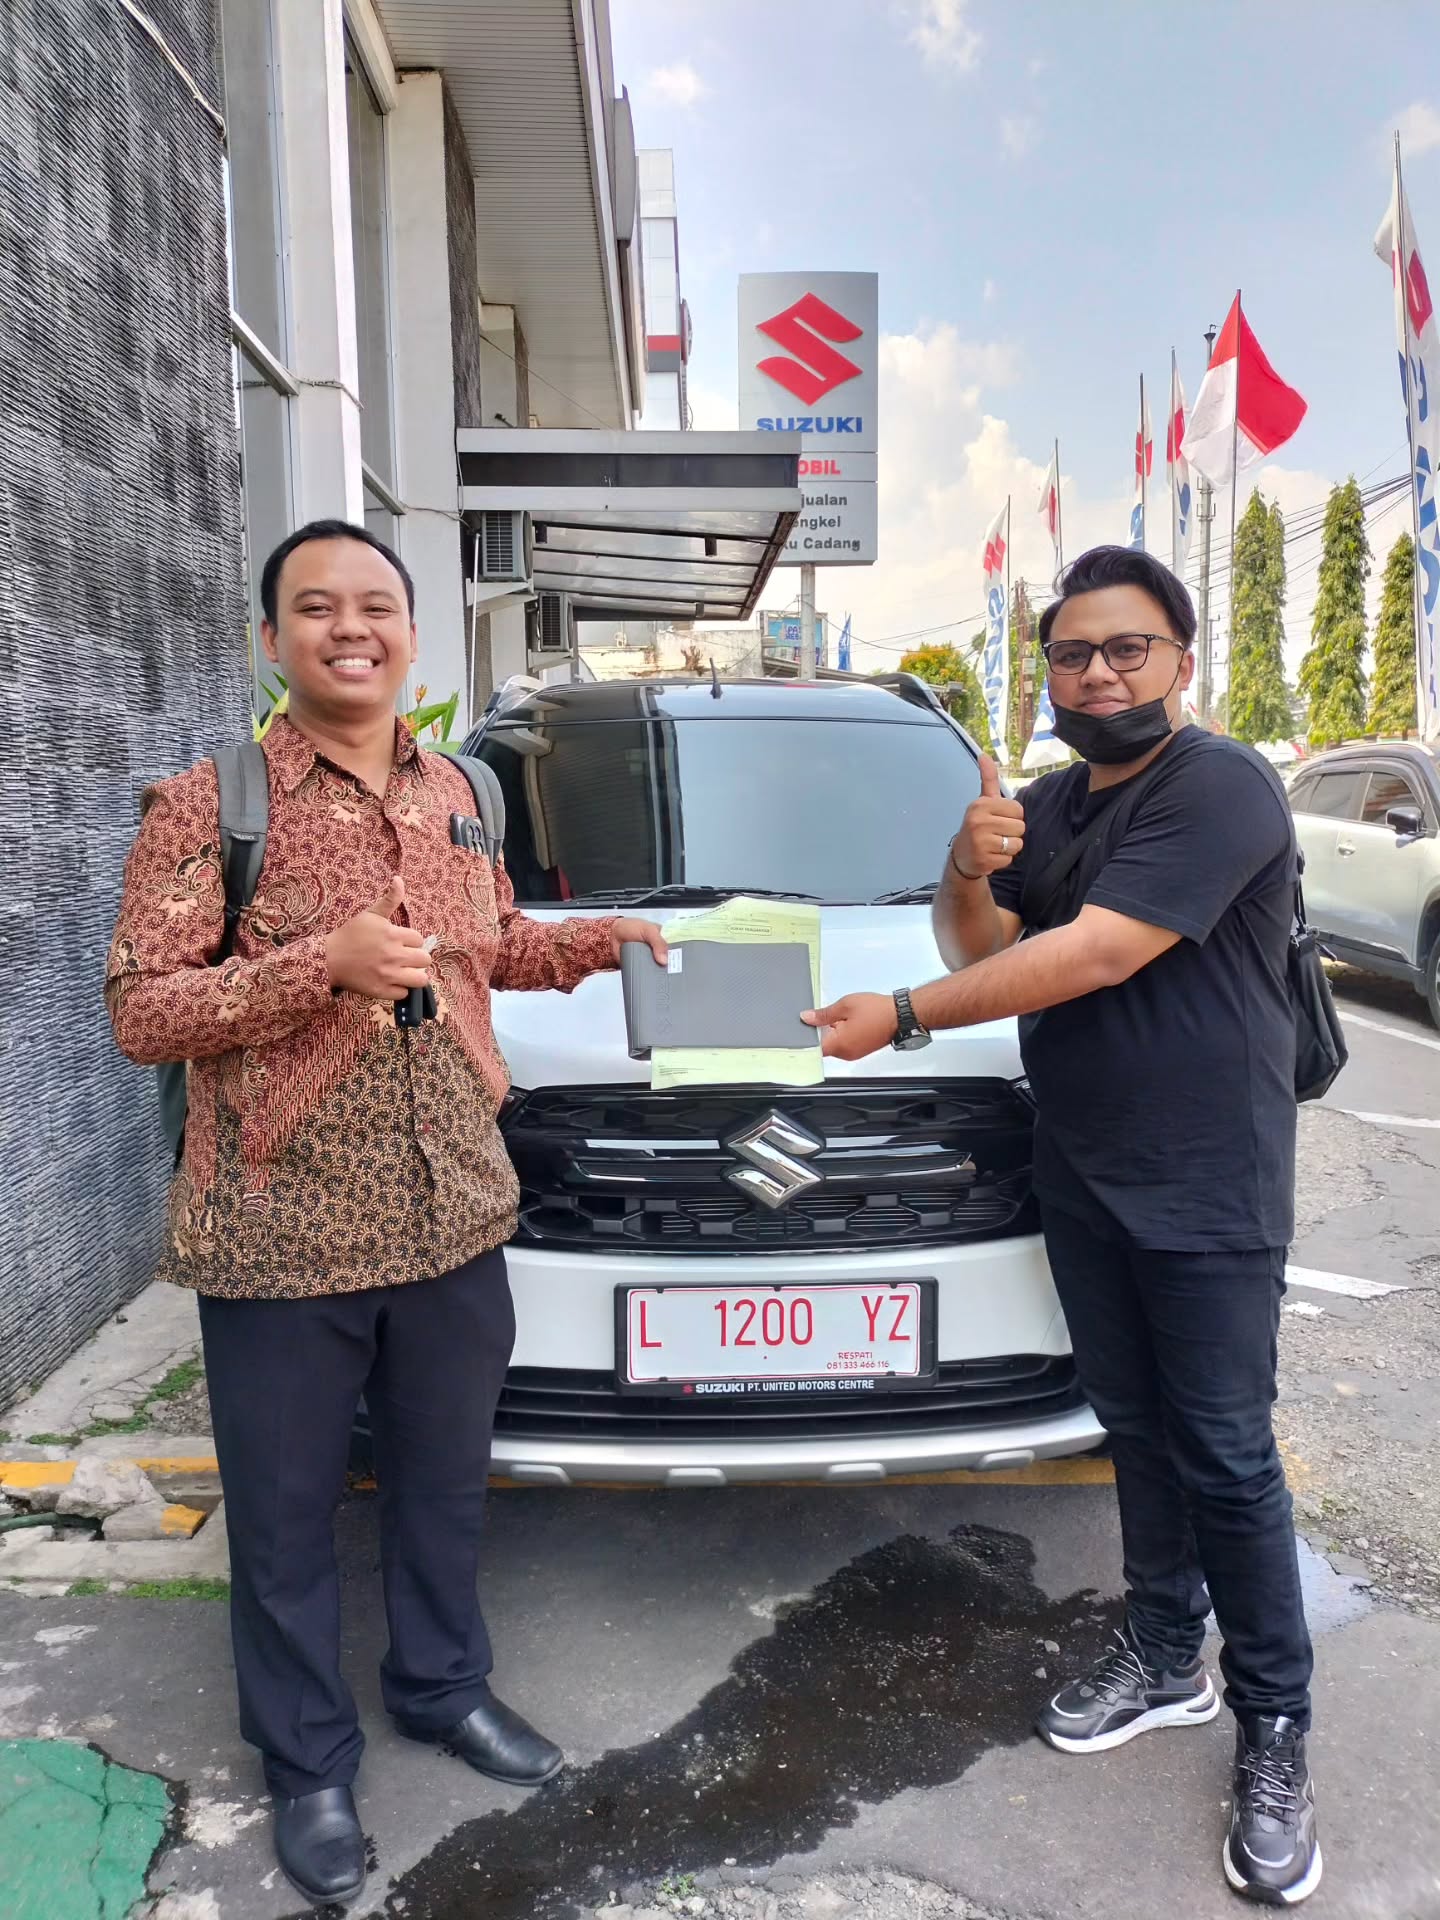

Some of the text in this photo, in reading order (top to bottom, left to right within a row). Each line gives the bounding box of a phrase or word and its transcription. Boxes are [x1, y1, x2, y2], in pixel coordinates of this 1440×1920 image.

[756, 416, 863, 433] SUZUKI
[798, 459, 842, 475] OBIL
[800, 493, 848, 509] jualan
[791, 515, 841, 530] engkel
[803, 537, 861, 551] Cadang
[639, 1295, 910, 1348] L 1200 YZ
[838, 1352, 873, 1360] RESPATI
[695, 1380, 874, 1393] SUZUKI PT. UNITED MOTORS CENTRE
